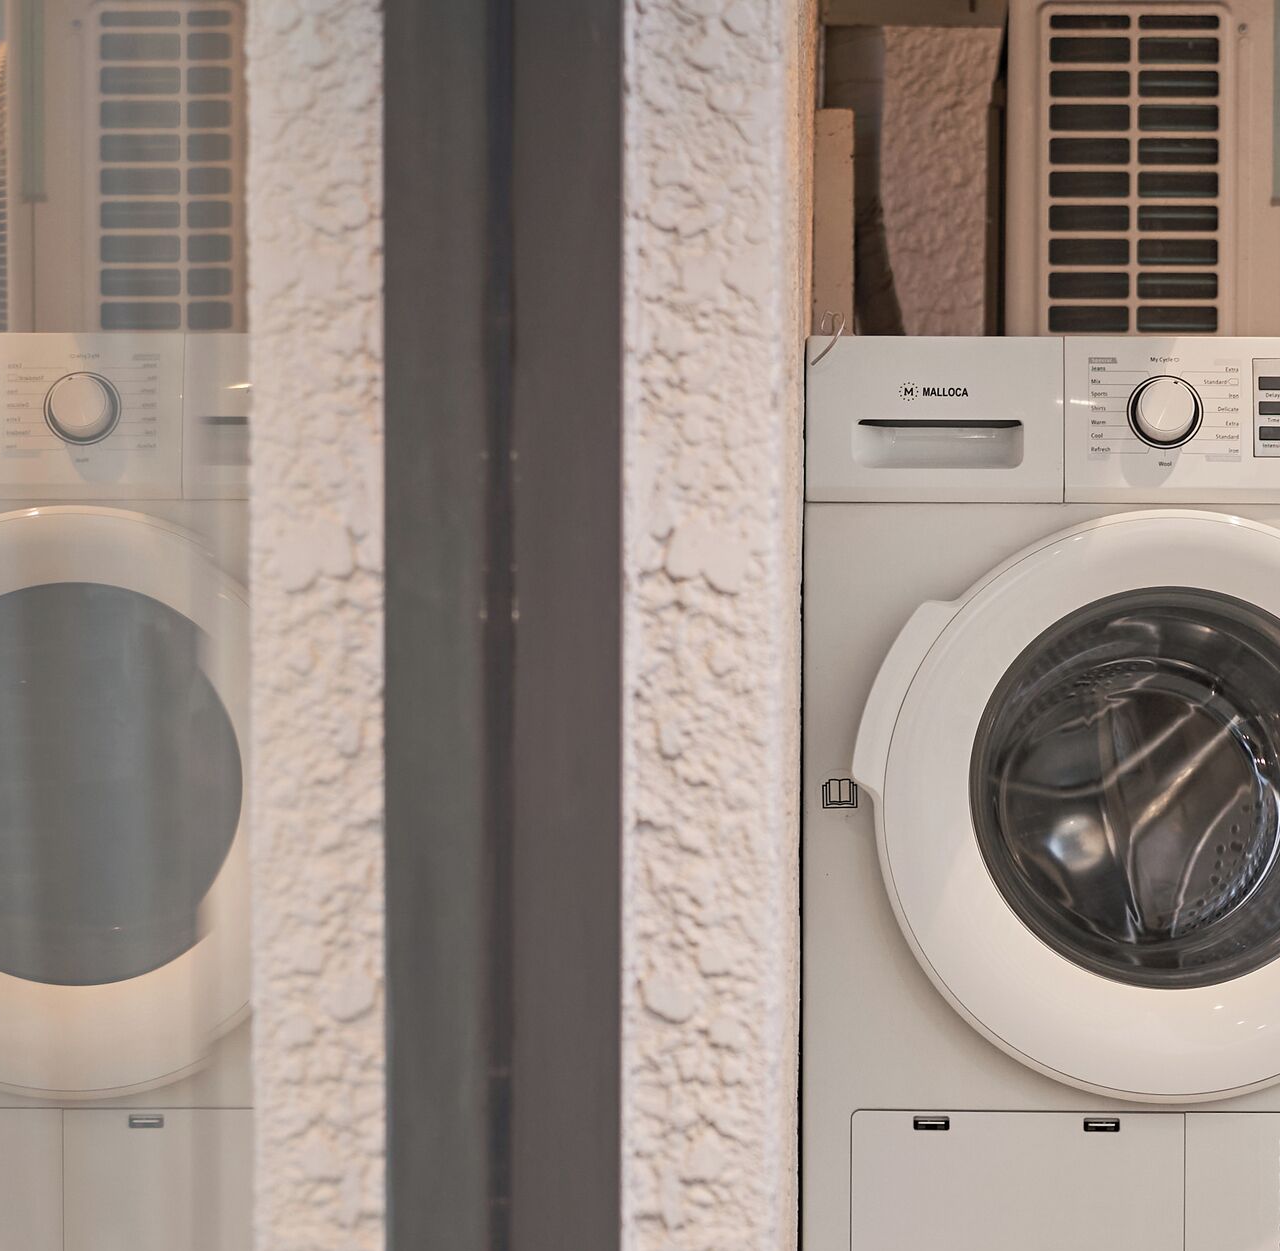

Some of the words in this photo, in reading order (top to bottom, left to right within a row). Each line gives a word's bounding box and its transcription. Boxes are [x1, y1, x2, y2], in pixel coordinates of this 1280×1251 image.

[1149, 356, 1159, 364] My
[1159, 356, 1174, 364] Cycle
[922, 386, 969, 398] MALLOCA
